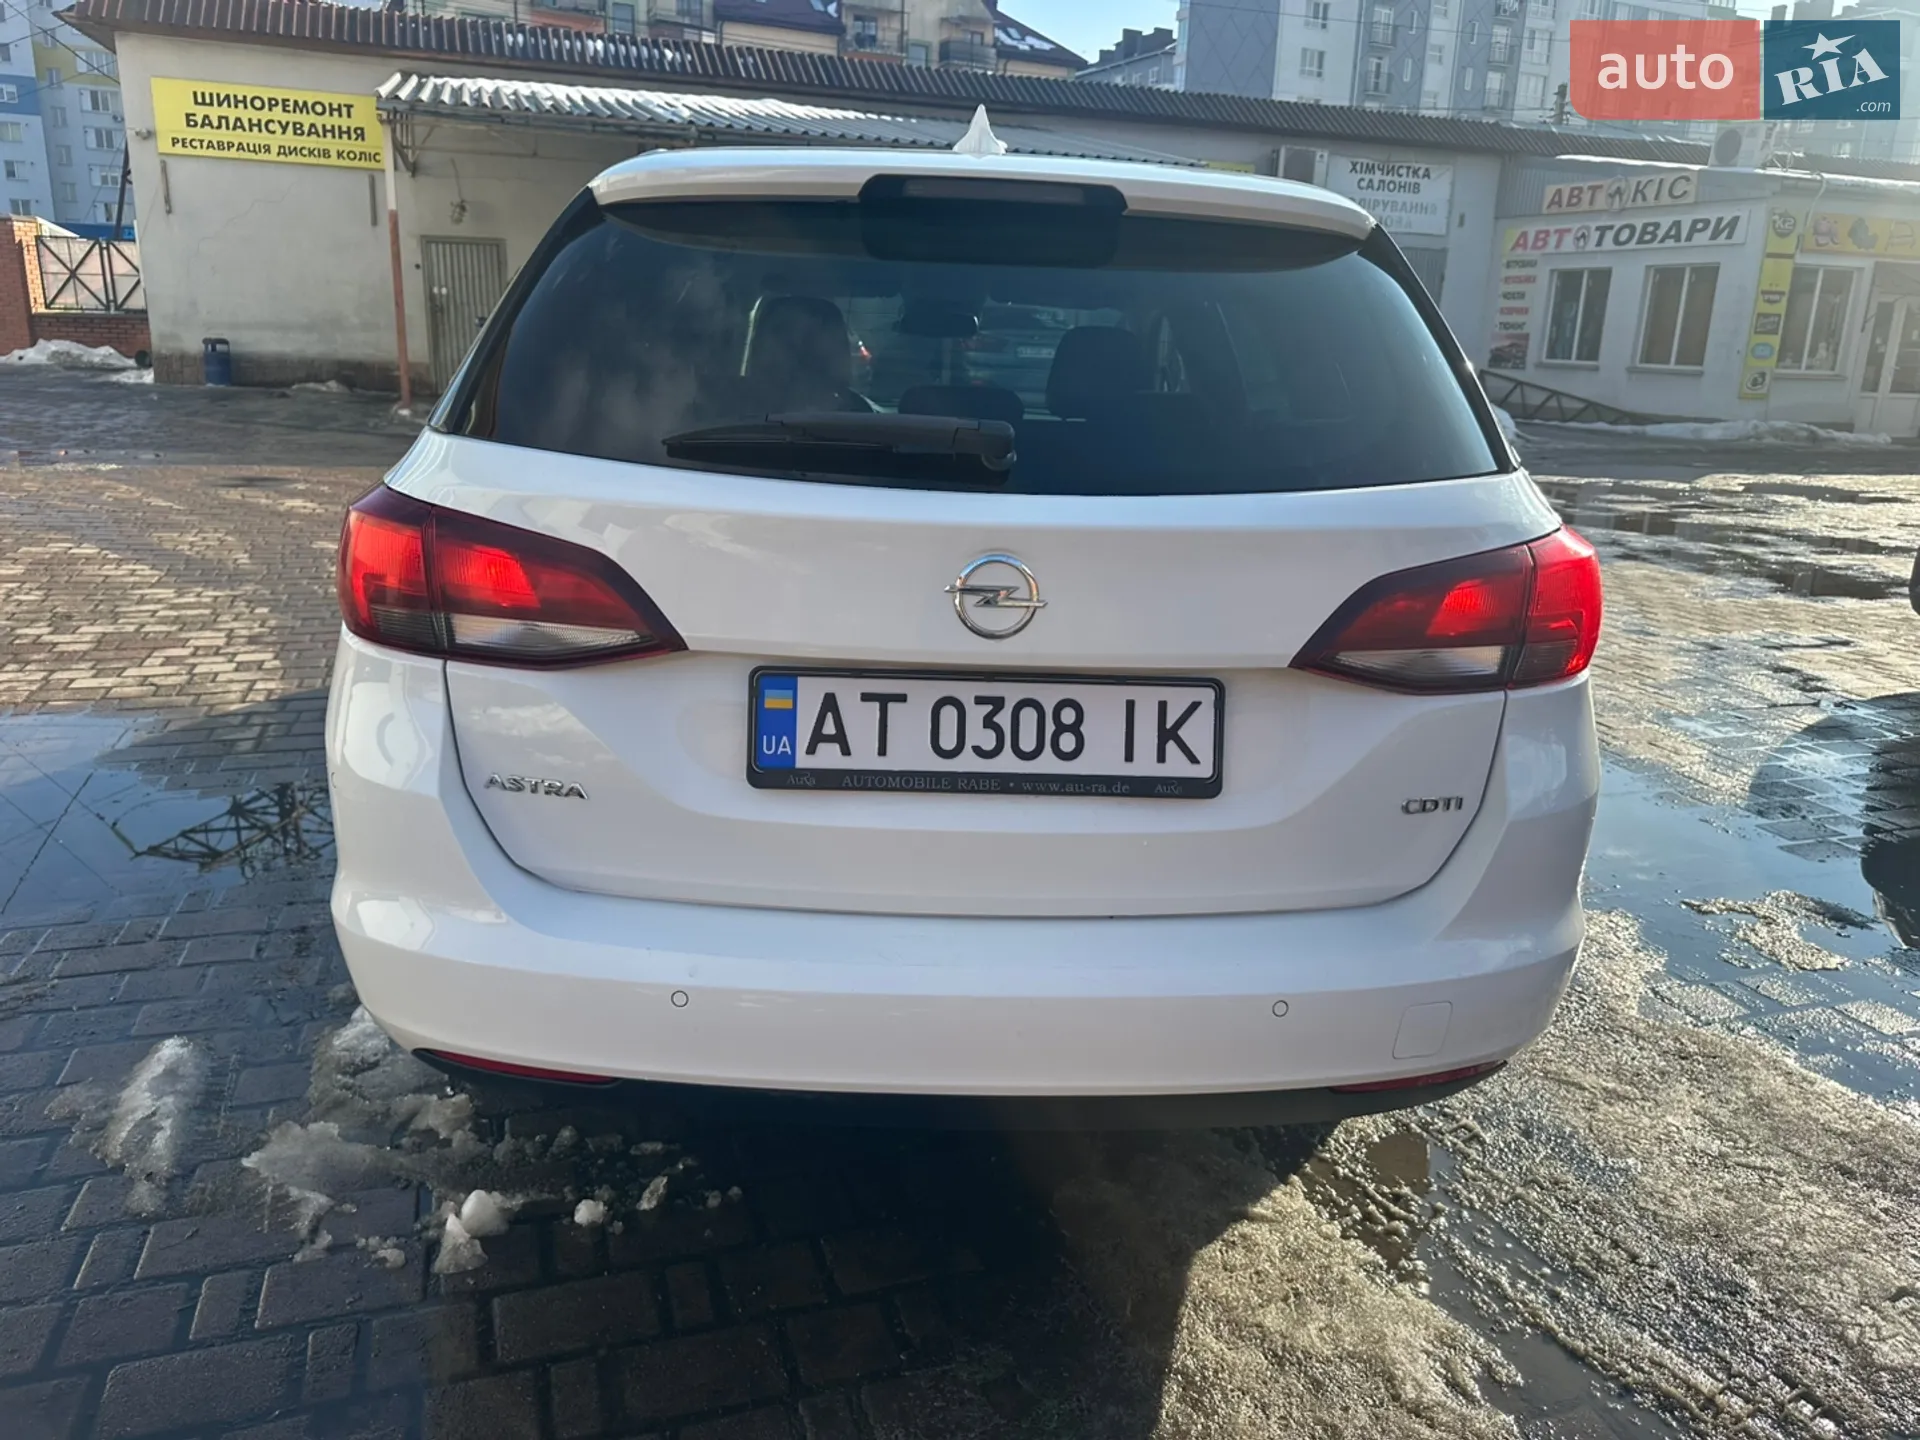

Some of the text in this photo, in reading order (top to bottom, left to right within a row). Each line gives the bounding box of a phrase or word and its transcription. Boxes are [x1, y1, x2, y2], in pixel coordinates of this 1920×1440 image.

[192, 90, 354, 119] ШИНОРЕМОНТ
[185, 112, 366, 142] БАЛАНСУВАННЯ
[171, 136, 382, 164] РЕСТАВРАЦІЯ ДИСКІВ КОЛІС
[1349, 160, 1431, 180] ХІМЧИСТКА
[1356, 177, 1421, 195] САЛОНІВ
[805, 692, 1203, 765] AT 0308 IK
[763, 735, 791, 756] UA
[483, 772, 589, 801] ASTRA
[841, 774, 1130, 794] AUTOMOBILE RABE www.au-ra.de
[1401, 796, 1464, 815] CDTI
